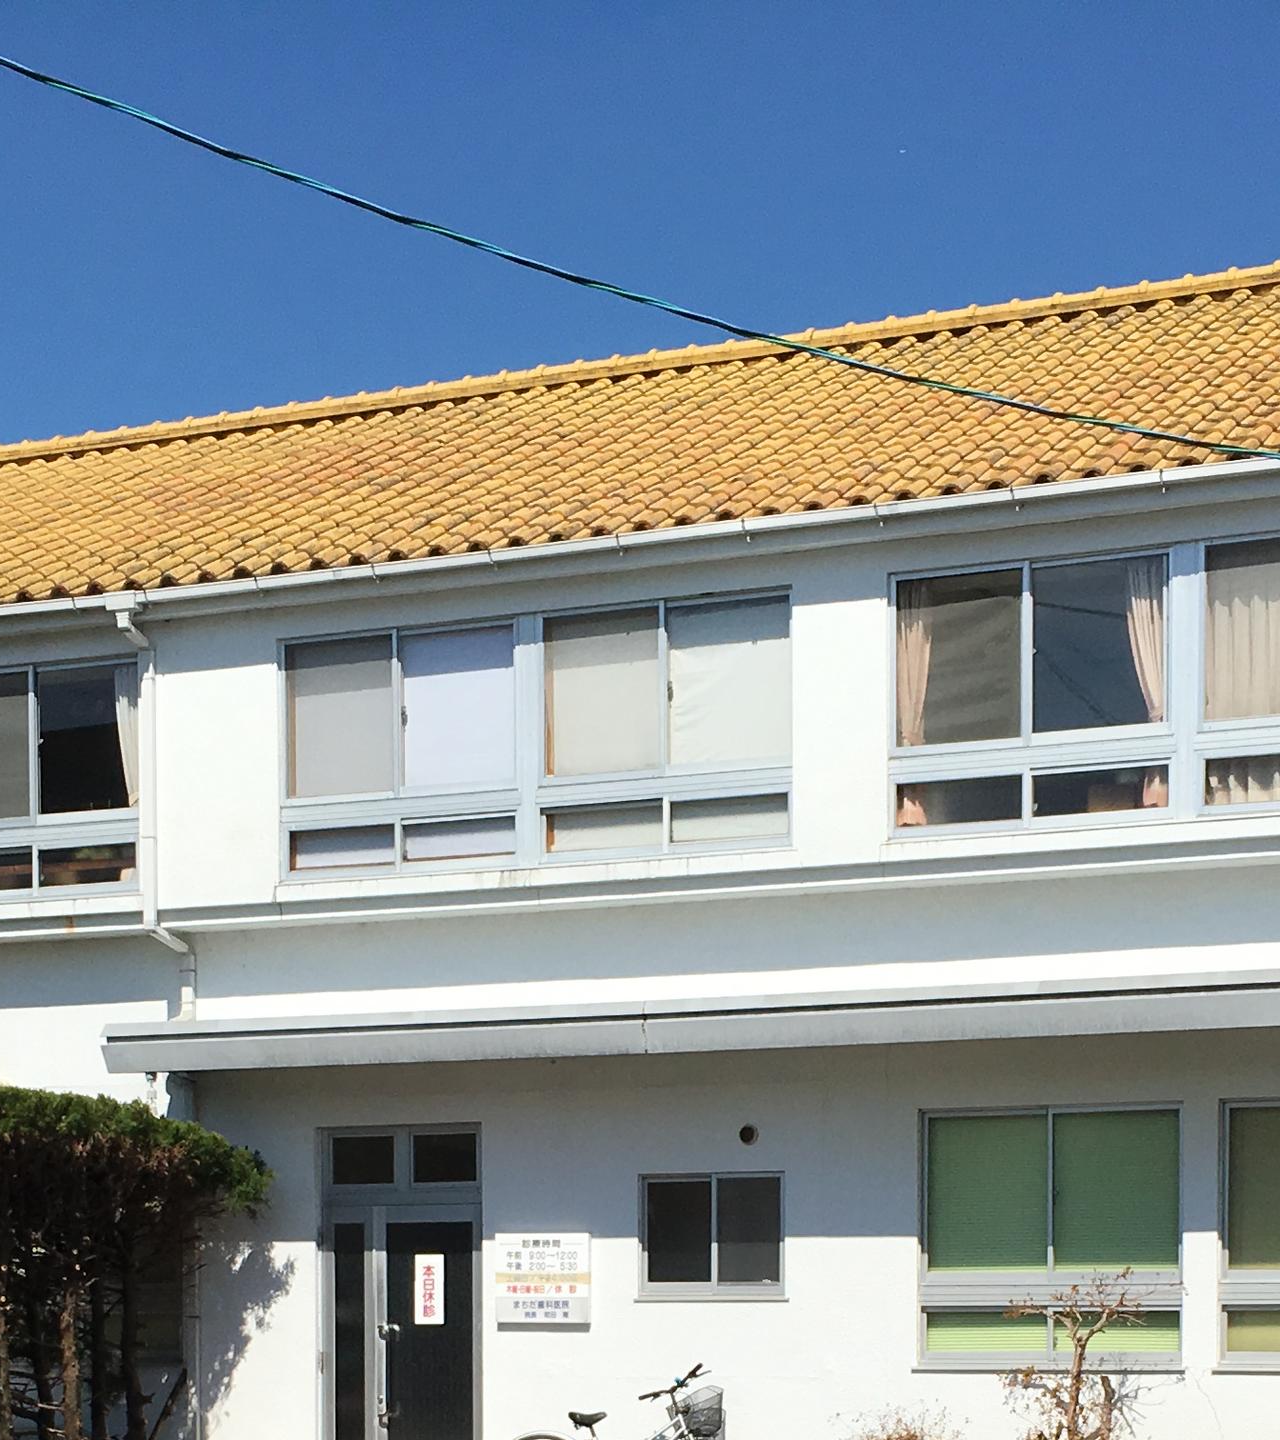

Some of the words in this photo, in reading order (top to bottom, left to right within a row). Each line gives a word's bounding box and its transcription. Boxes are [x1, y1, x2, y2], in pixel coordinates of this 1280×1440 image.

[521, 1239, 561, 1248] 診療時間
[506, 1251, 522, 1260] 午前
[506, 1262, 522, 1271] 午後
[423, 1265, 436, 1318] 本日休診
[513, 1300, 570, 1309] まちだ歯科医院
